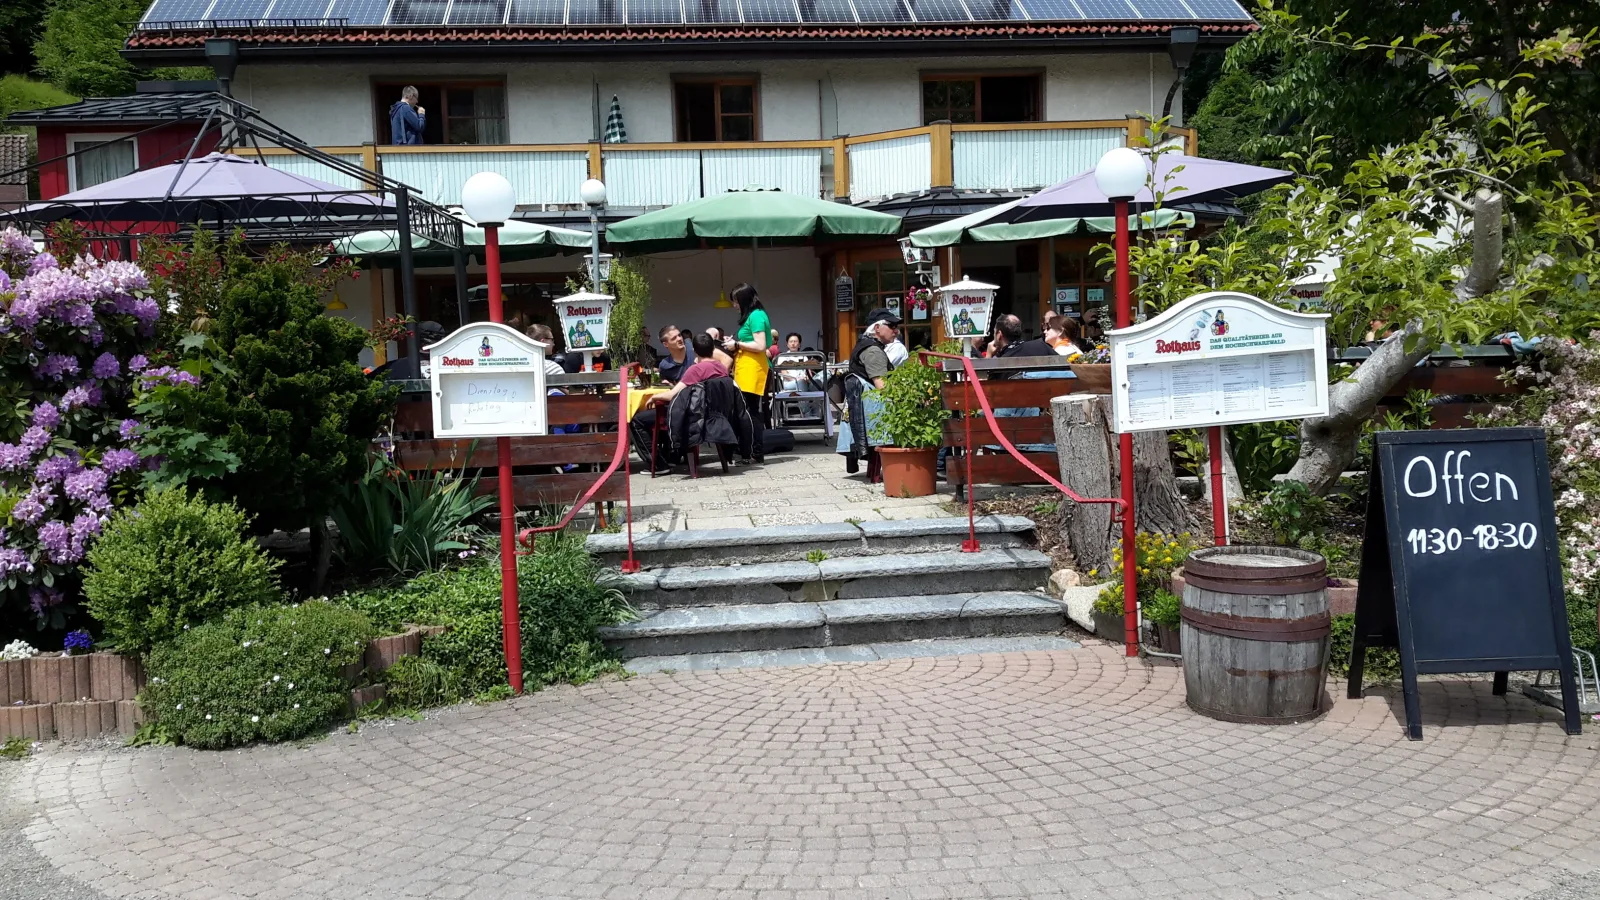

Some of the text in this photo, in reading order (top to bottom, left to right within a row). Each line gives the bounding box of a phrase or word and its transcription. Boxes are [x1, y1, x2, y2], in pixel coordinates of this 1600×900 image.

[952, 294, 986, 306] Rothaus
[567, 306, 602, 317] Rothaus
[1155, 340, 1201, 355] Rothaus
[1225, 339, 1286, 349] HOCHSCHWARZWALD
[442, 356, 474, 368] Rothaus
[467, 383, 508, 397] Dienstag
[1404, 450, 1518, 504] Offen
